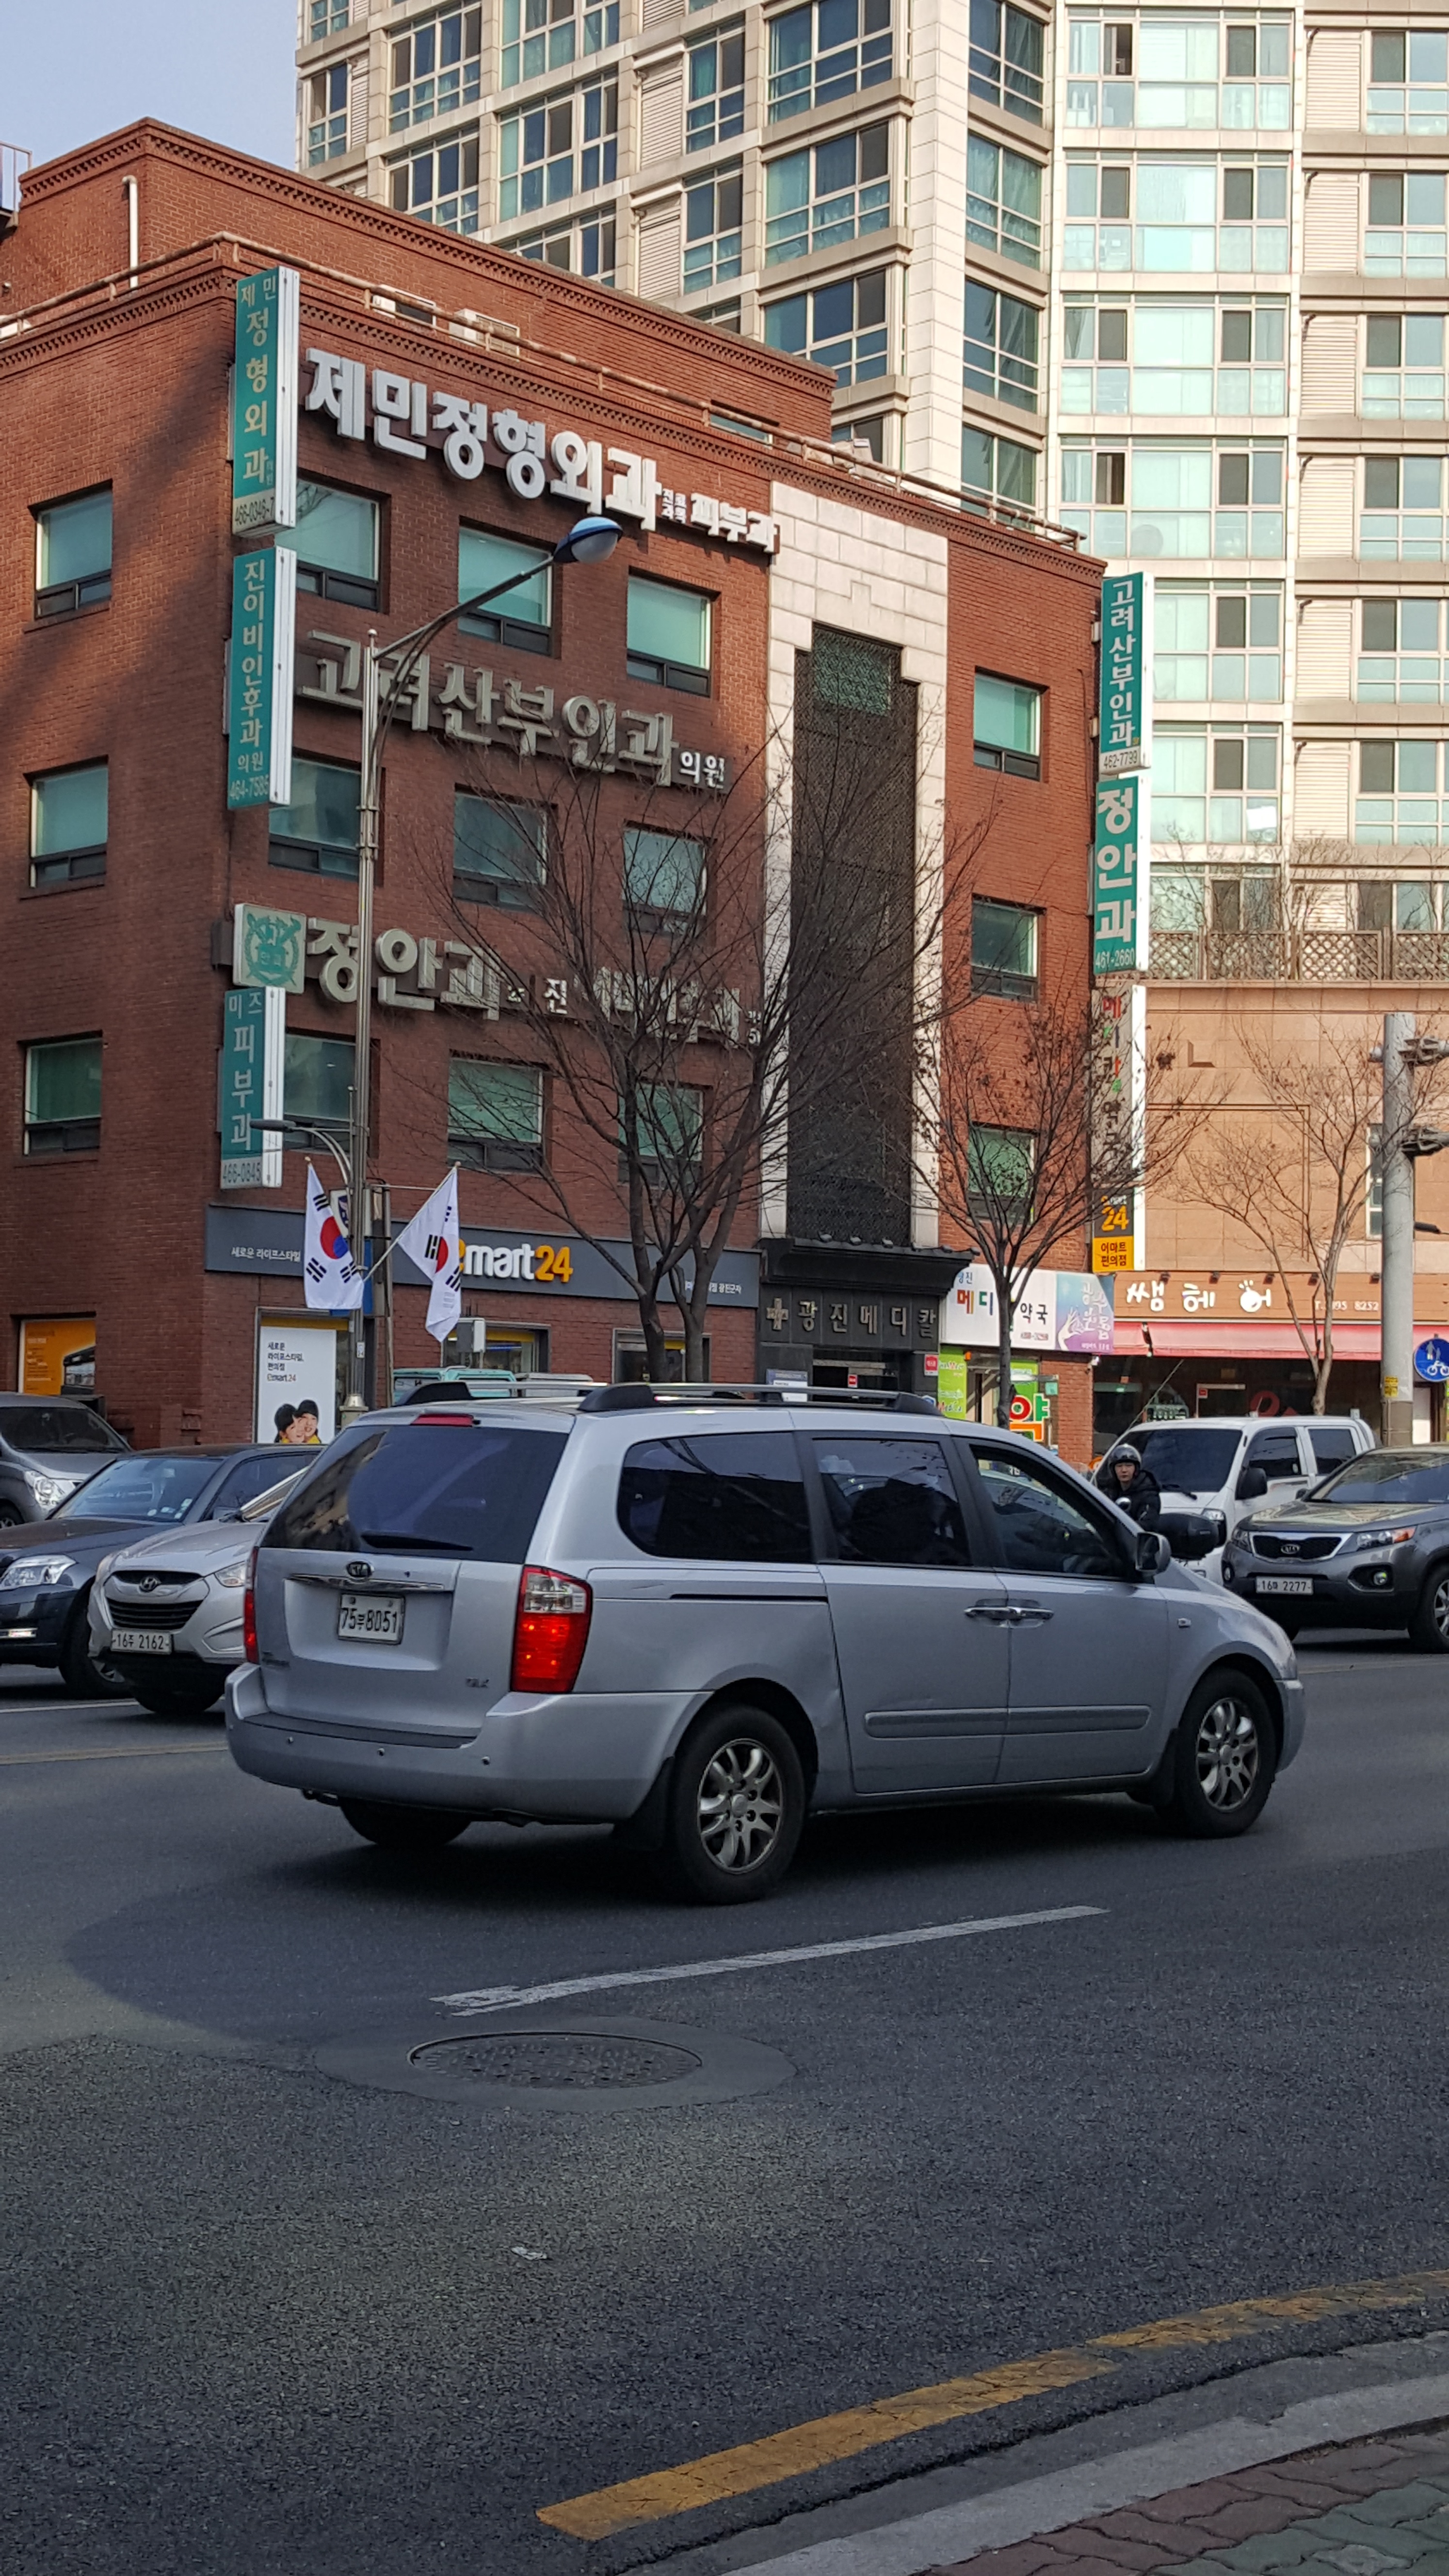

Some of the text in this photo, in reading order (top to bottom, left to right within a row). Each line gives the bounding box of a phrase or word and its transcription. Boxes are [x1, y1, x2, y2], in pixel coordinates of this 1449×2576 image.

[243, 308, 269, 484] 정형외과
[306, 347, 662, 531] 제민정형외과
[691, 492, 777, 553] 피부과
[241, 559, 265, 747] 진이비인후과
[1109, 580, 1136, 747] 고려산부인과
[296, 629, 724, 789] 고려산부인과 의원
[237, 751, 263, 773] 의원
[1095, 787, 1136, 943] 정안과
[307, 917, 499, 1021] 정안과
[228, 991, 262, 1019] 미즈
[231, 1024, 255, 1151] 피부과
[1101, 1205, 1129, 1232] 24
[231, 1246, 255, 1258] 새로운
[458, 1238, 573, 1283] mart24
[1101, 1241, 1127, 1254] 이마트
[1101, 1254, 1127, 1267] 편의점
[798, 1300, 937, 1338] 광진메디칼
[1020, 1302, 1048, 1325] 약국
[1283, 1581, 1307, 1592] 2277
[139, 1635, 164, 1650] 2162
